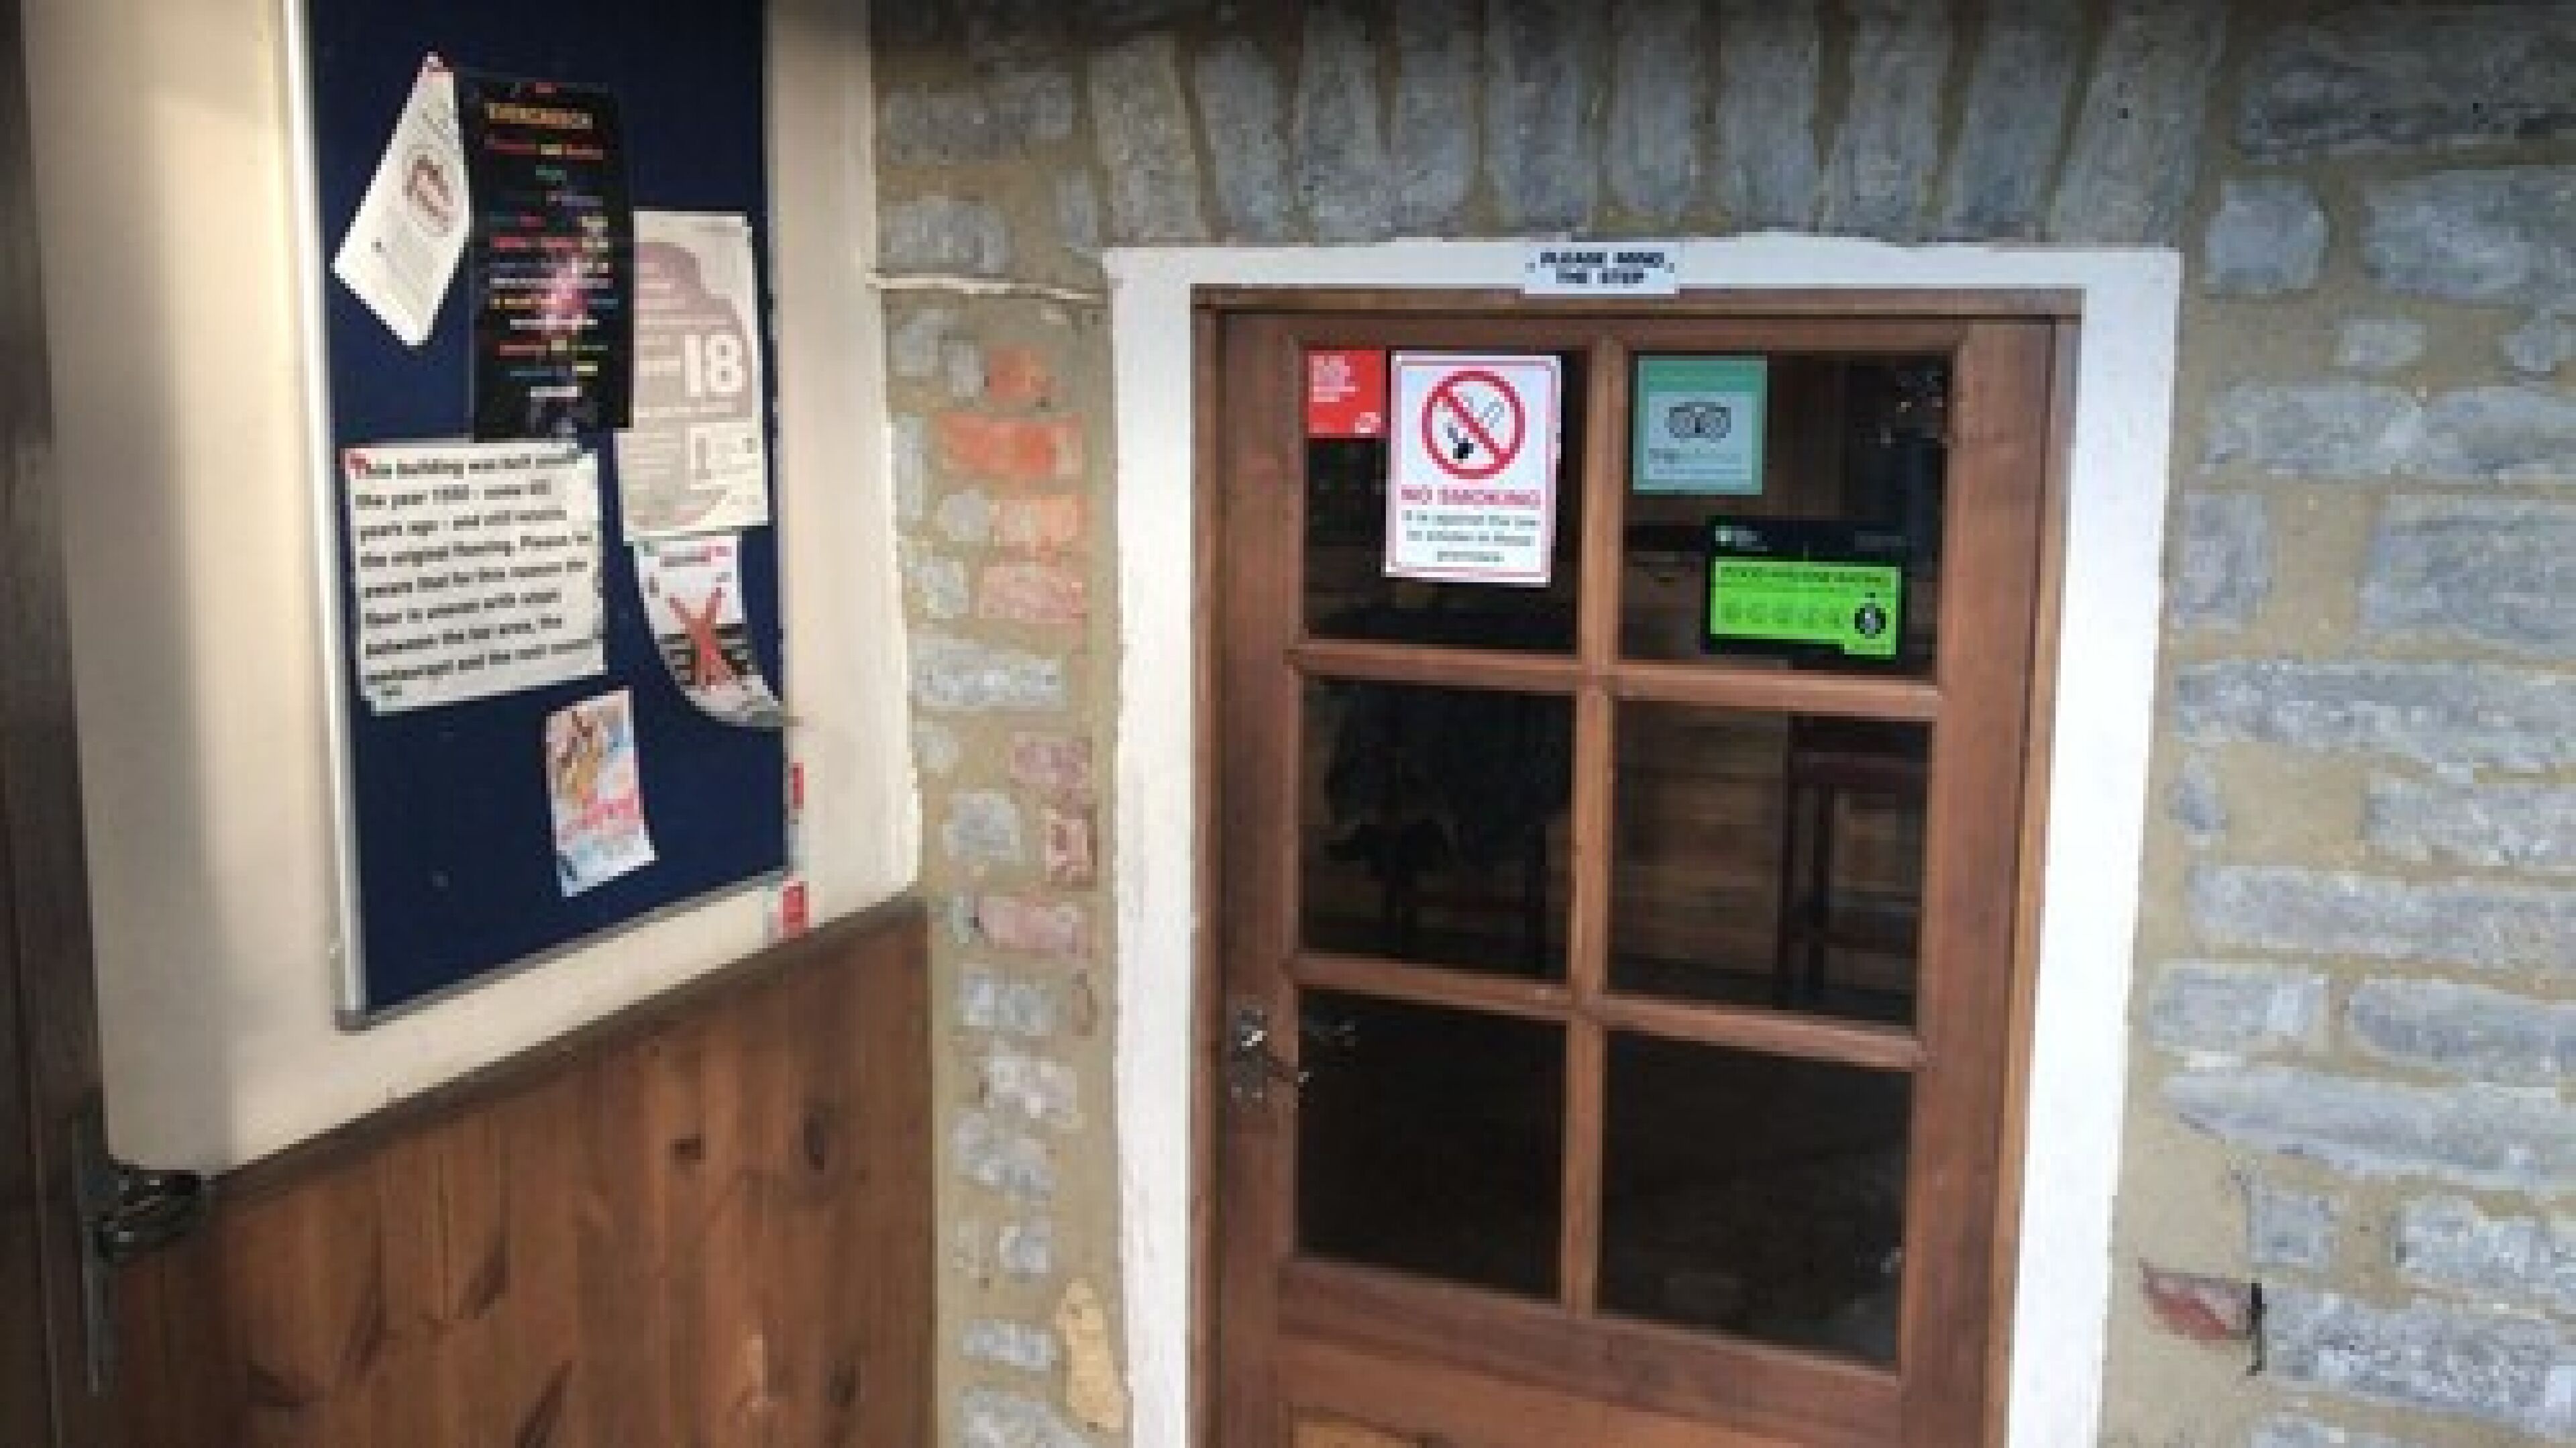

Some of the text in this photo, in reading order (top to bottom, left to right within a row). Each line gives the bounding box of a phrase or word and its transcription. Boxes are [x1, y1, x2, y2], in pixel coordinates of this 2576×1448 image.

[1540, 250, 1664, 267] PLEASE MIND
[1556, 270, 1645, 284] THE STEP
[682, 331, 745, 399] 18
[356, 492, 385, 509] the
[390, 492, 427, 511] year
[1401, 486, 1541, 509] NO SMOKING
[360, 552, 386, 569] the
